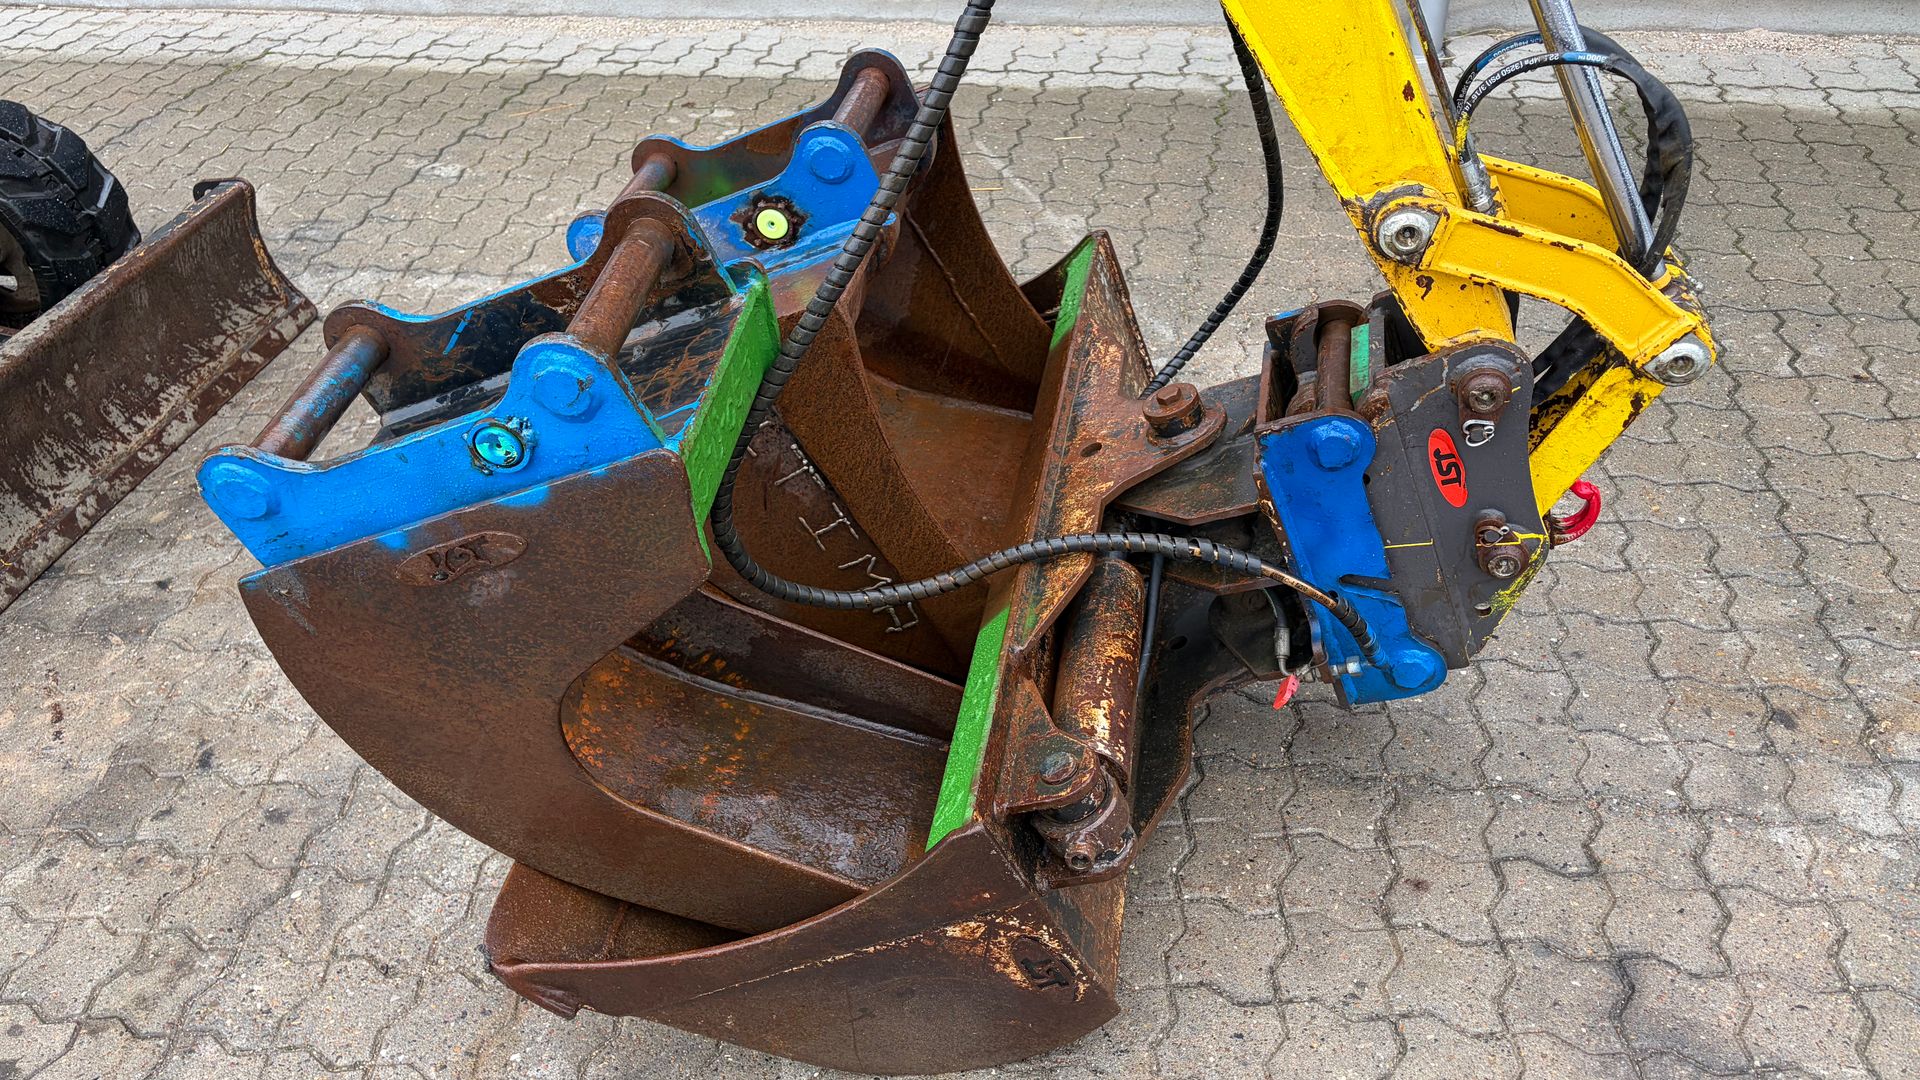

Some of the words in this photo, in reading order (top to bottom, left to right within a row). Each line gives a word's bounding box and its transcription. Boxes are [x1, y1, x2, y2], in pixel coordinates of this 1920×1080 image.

[1501, 60, 1524, 77] (3250
[1486, 73, 1501, 87] PSI)
[1433, 447, 1462, 488] JST
